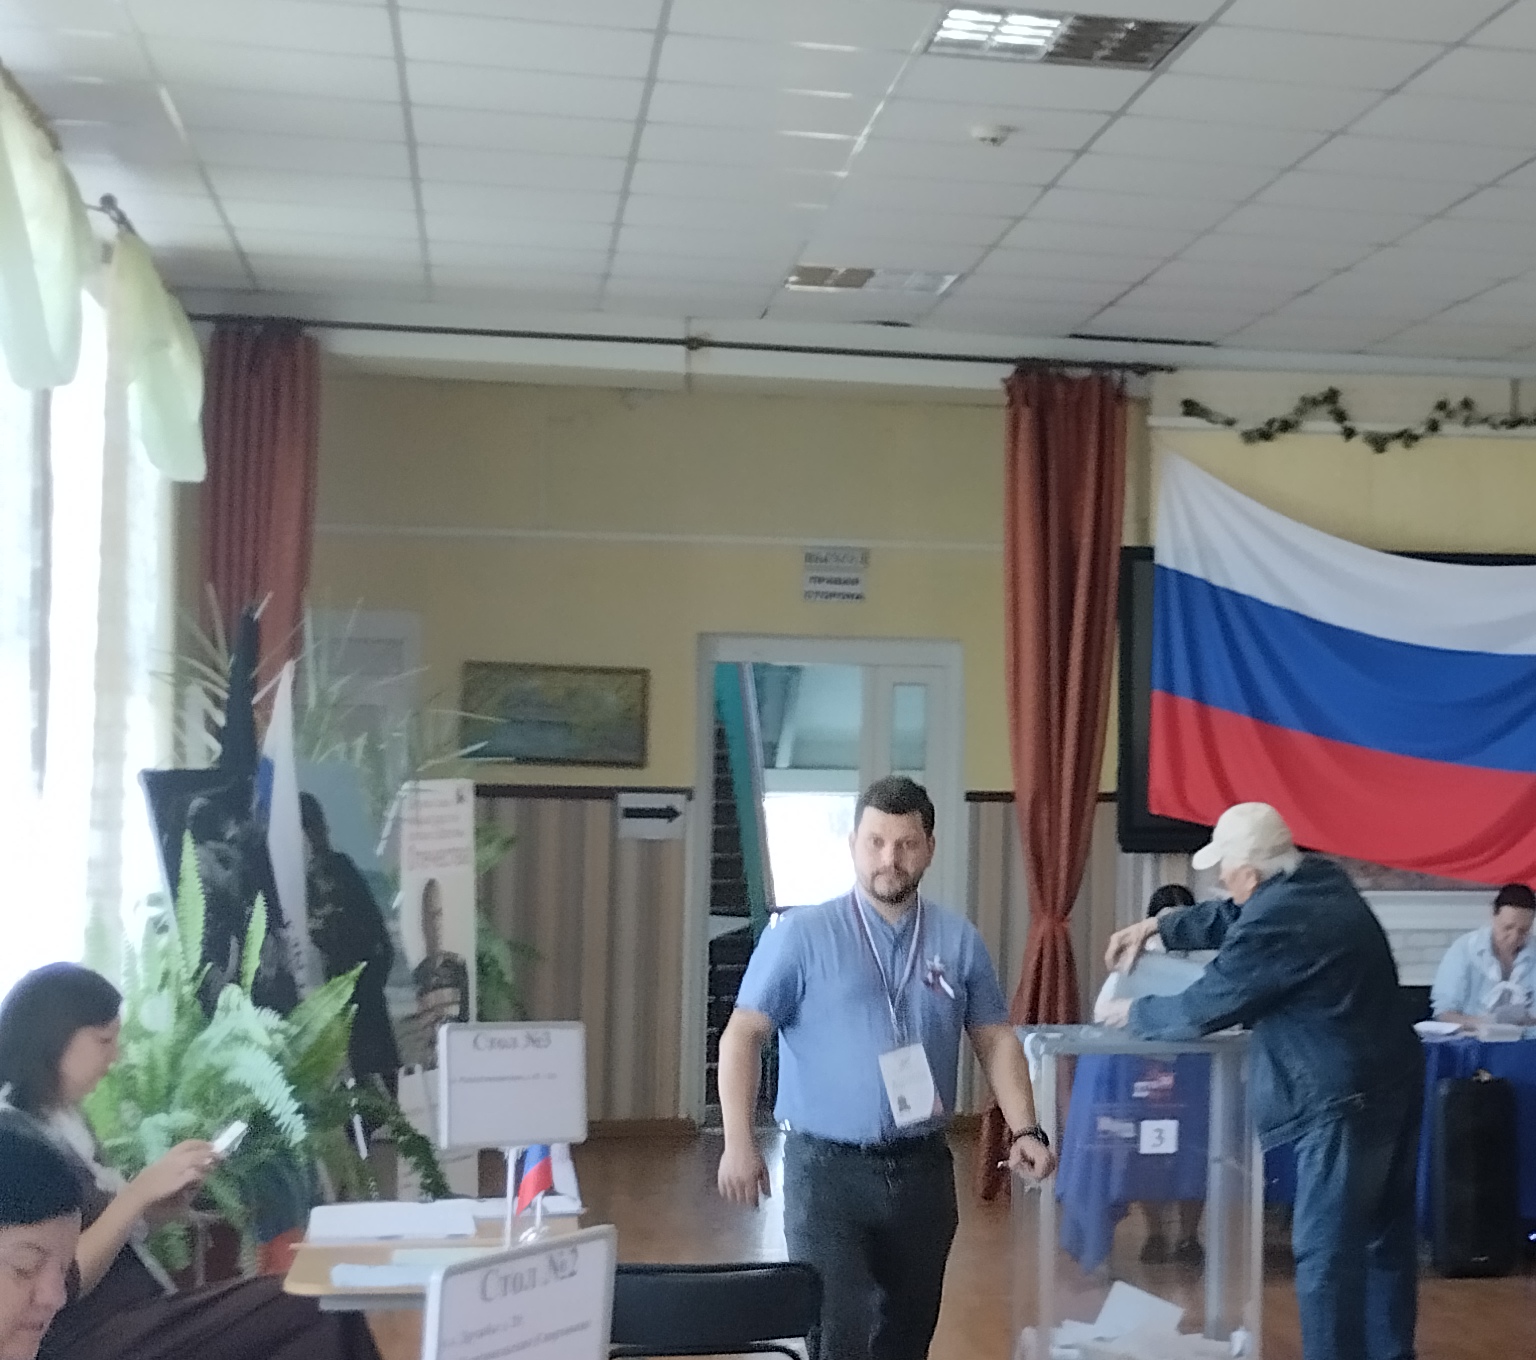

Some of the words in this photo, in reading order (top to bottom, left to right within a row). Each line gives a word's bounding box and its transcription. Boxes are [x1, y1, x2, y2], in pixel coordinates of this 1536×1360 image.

[1151, 1127, 1166, 1148] 3
[480, 1267, 538, 1303] Стол
[542, 1243, 579, 1285] №2
